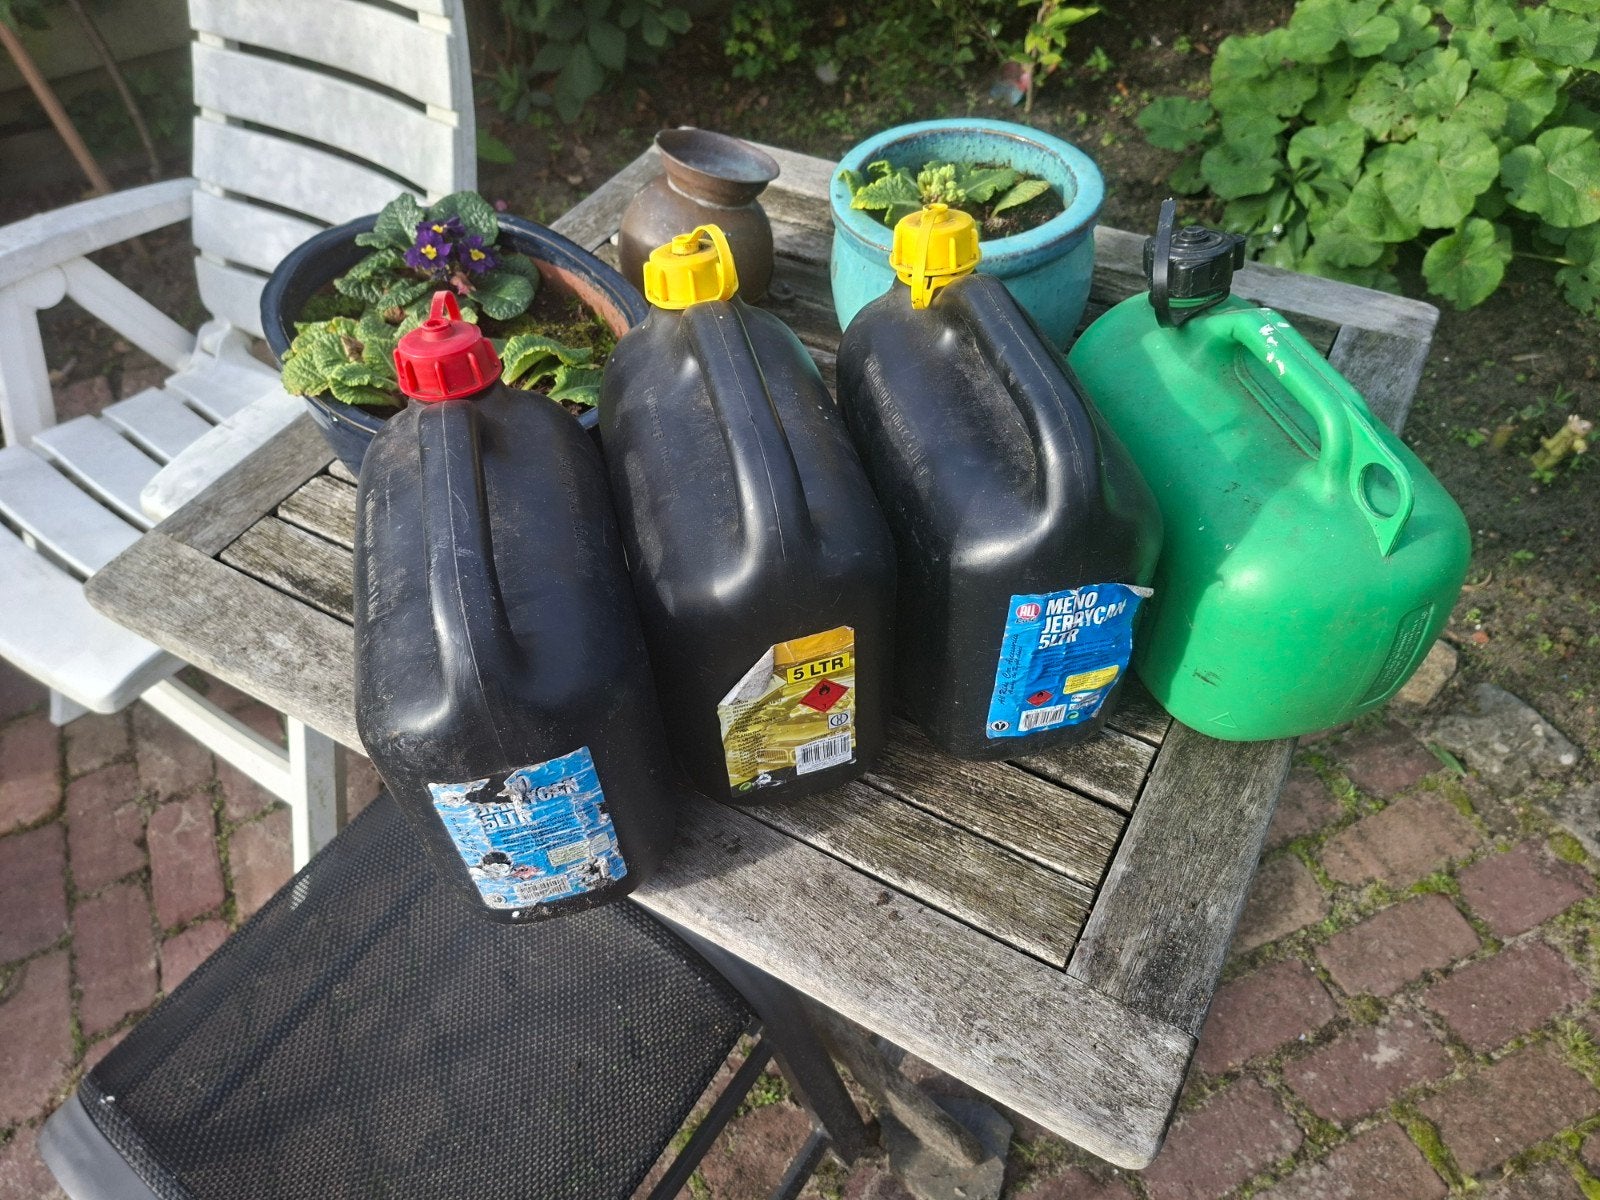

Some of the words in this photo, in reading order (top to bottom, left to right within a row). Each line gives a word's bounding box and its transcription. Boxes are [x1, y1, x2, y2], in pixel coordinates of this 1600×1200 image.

[1020, 604, 1036, 617] ALL
[1041, 598, 1127, 634] JERRYCAN
[1045, 591, 1098, 616] MENO
[1038, 628, 1080, 650] 5LTR
[793, 667, 805, 681] 5
[810, 656, 844, 676] LTR
